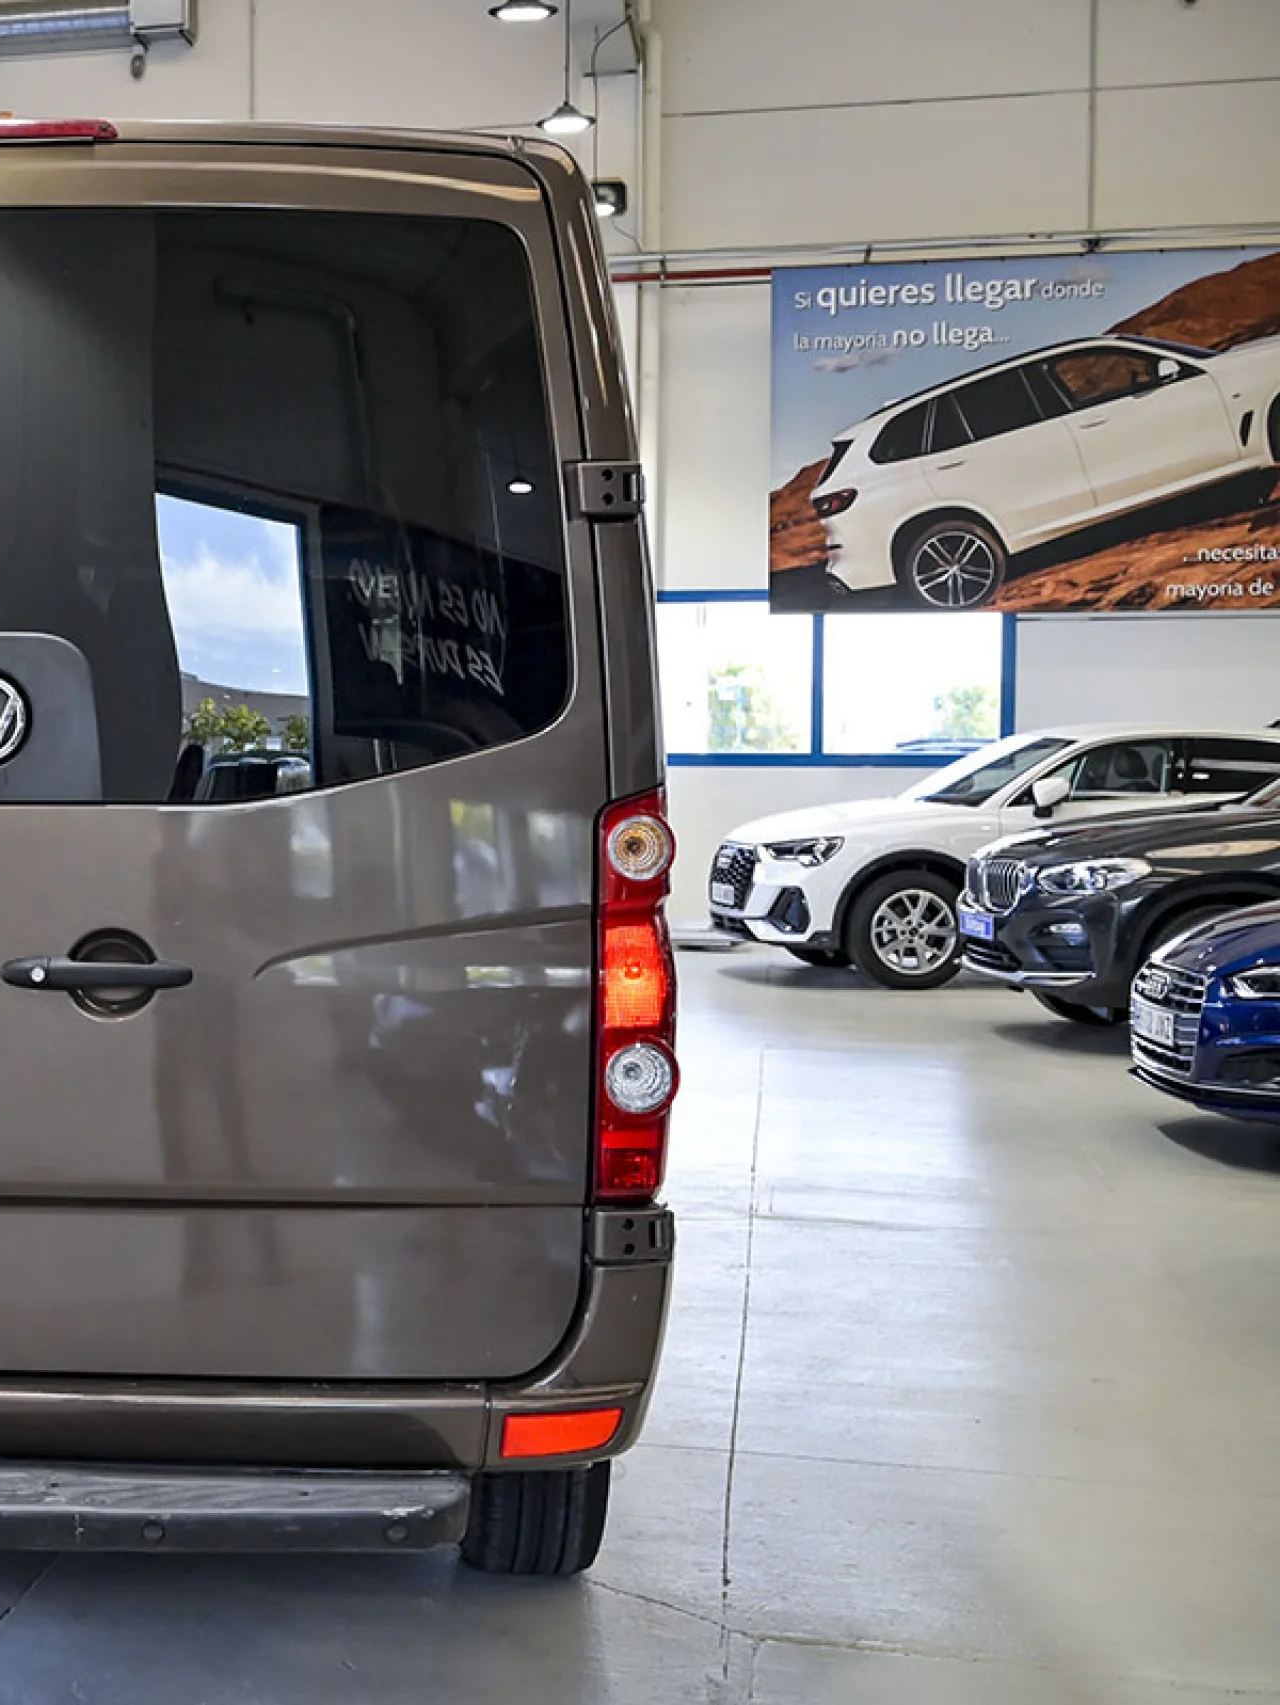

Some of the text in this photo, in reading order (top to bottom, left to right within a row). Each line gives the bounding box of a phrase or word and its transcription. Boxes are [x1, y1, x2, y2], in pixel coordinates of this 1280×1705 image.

[817, 279, 937, 316] quieres
[945, 273, 1038, 310] llegar
[1040, 278, 1106, 300] donde
[793, 332, 810, 350] la
[893, 329, 926, 346] no
[1248, 577, 1275, 597] de
